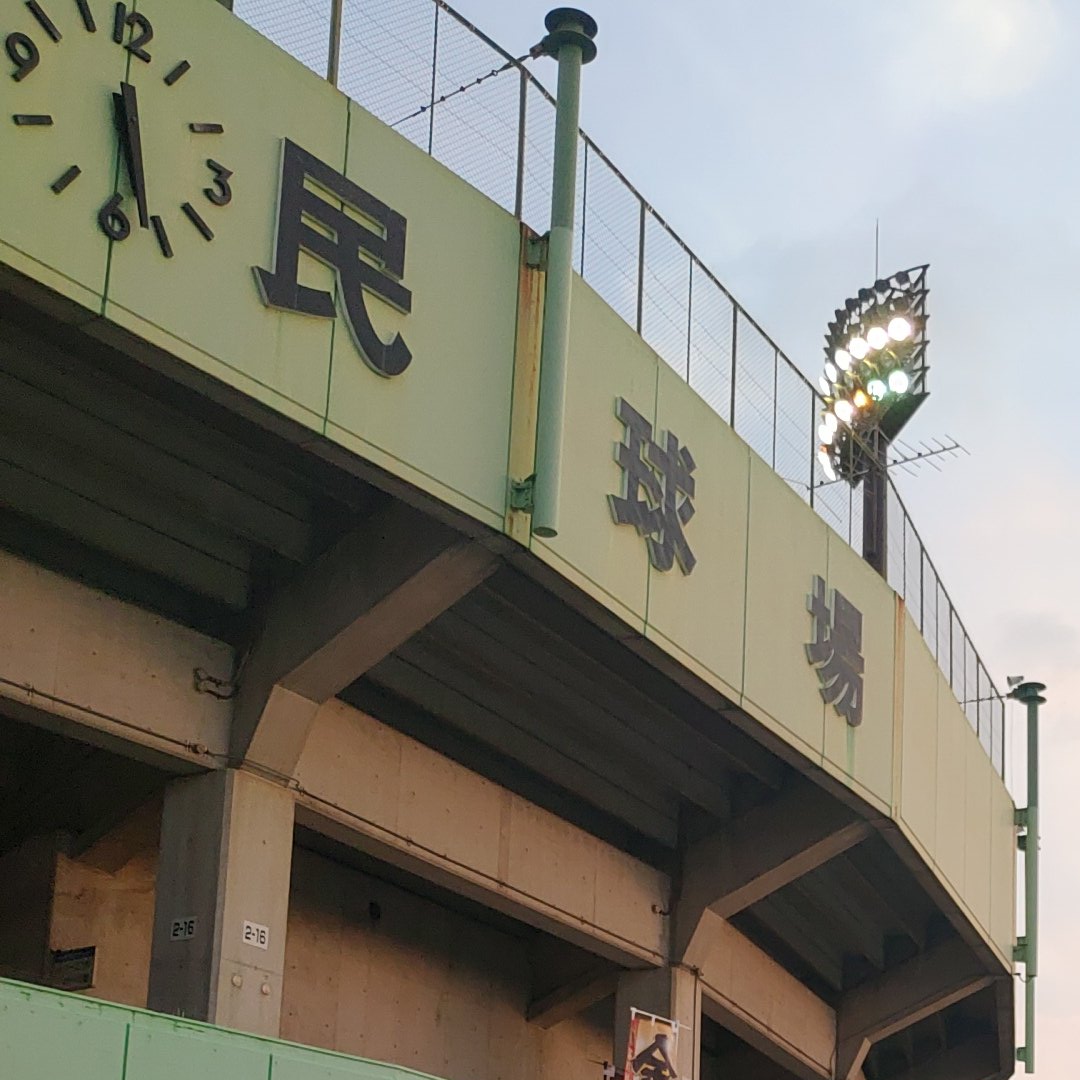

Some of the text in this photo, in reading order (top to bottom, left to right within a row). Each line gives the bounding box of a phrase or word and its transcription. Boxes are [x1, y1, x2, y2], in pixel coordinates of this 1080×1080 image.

[5, 31, 40, 82] 9
[114, 2, 154, 63] 12
[203, 158, 233, 206] 3
[98, 192, 131, 242] 6
[172, 920, 195, 937] 2-16
[244, 925, 267, 945] 2-16
